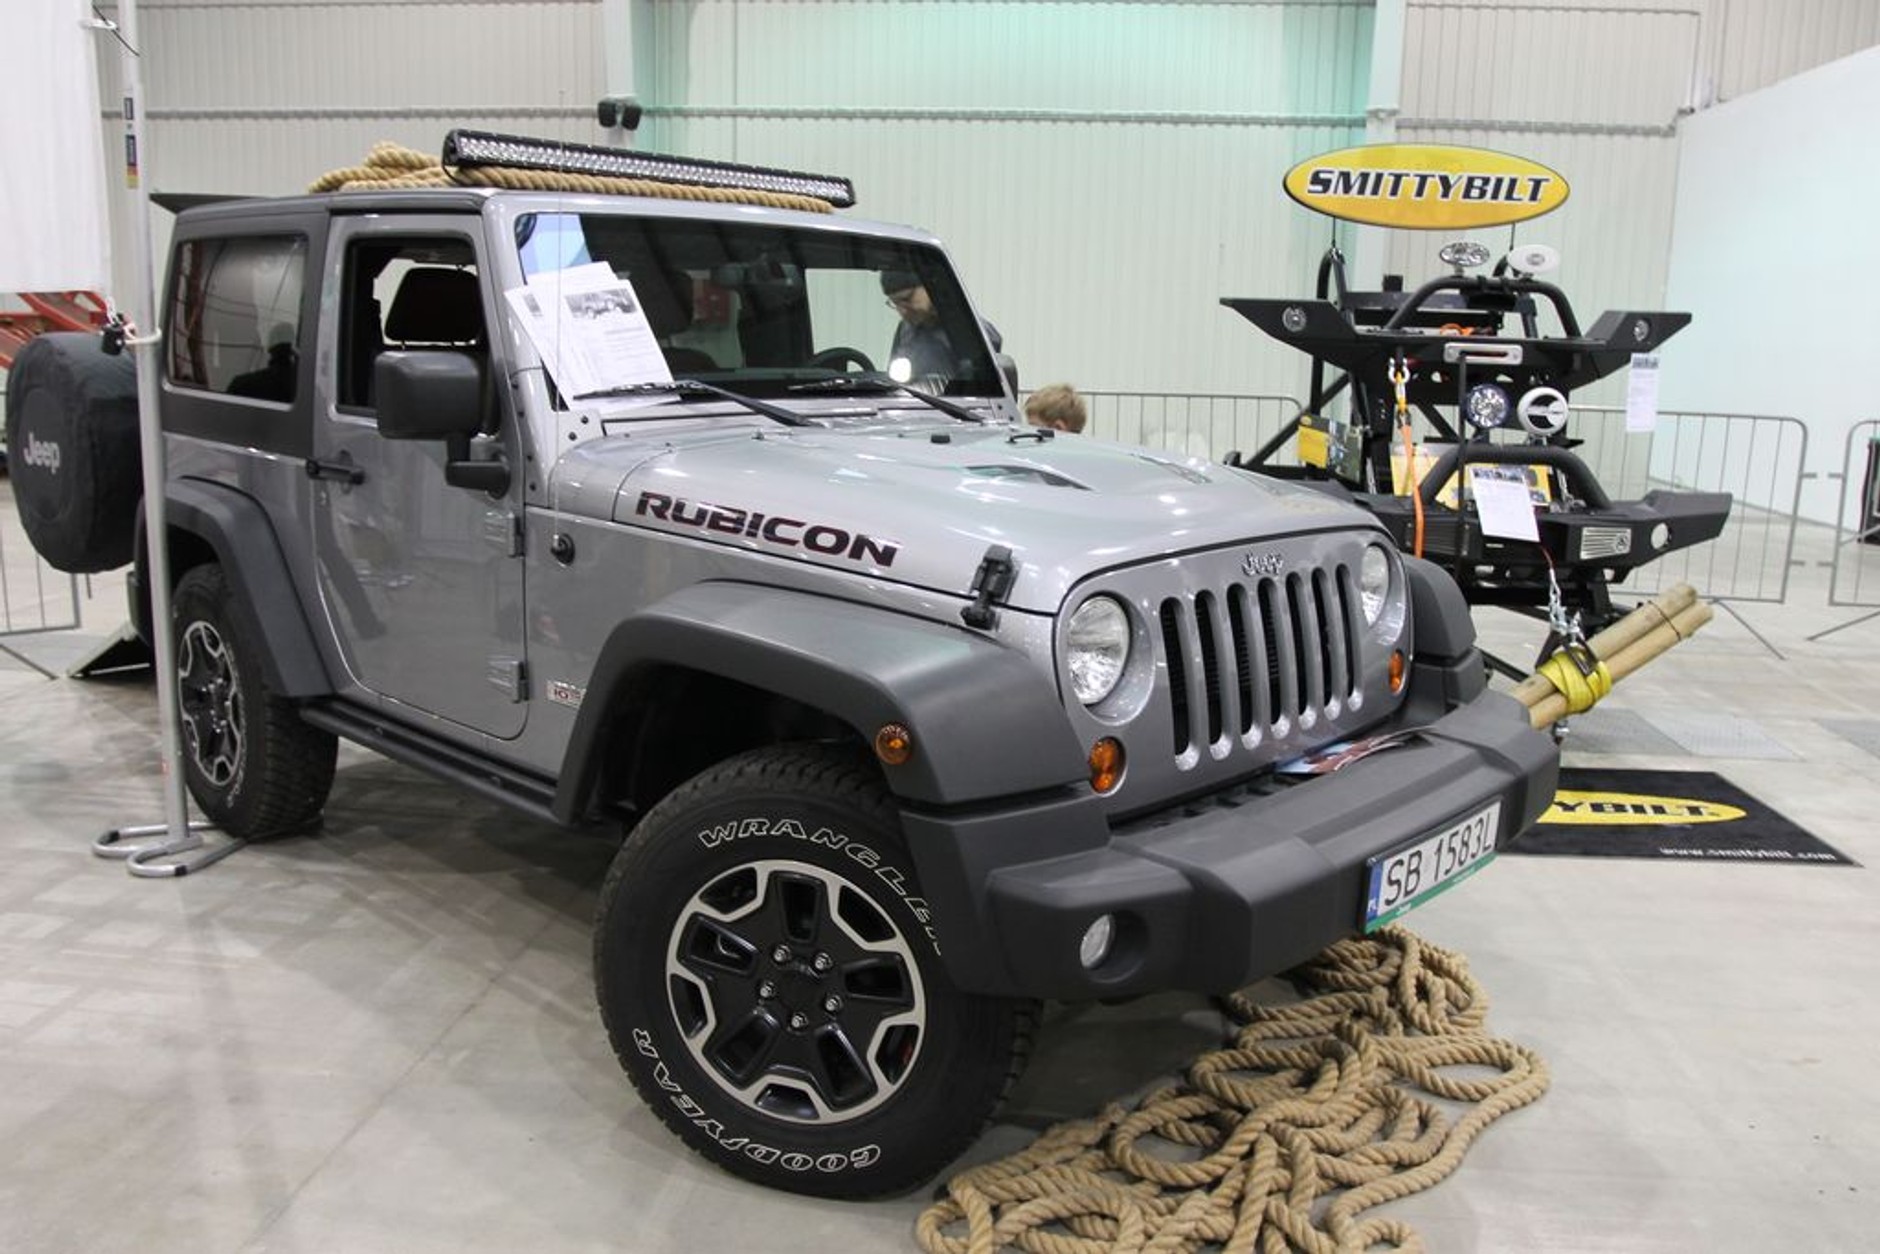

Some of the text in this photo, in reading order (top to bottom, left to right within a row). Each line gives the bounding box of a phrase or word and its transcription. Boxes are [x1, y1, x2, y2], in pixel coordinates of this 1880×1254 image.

[1306, 168, 1550, 203] SMITTYBILT
[23, 431, 60, 475] Jeep
[635, 490, 899, 567] RUBICON
[698, 817, 941, 957] WRANGLE
[1384, 812, 1492, 906] SB 1583L
[632, 1028, 881, 1173] GOODYEAR
